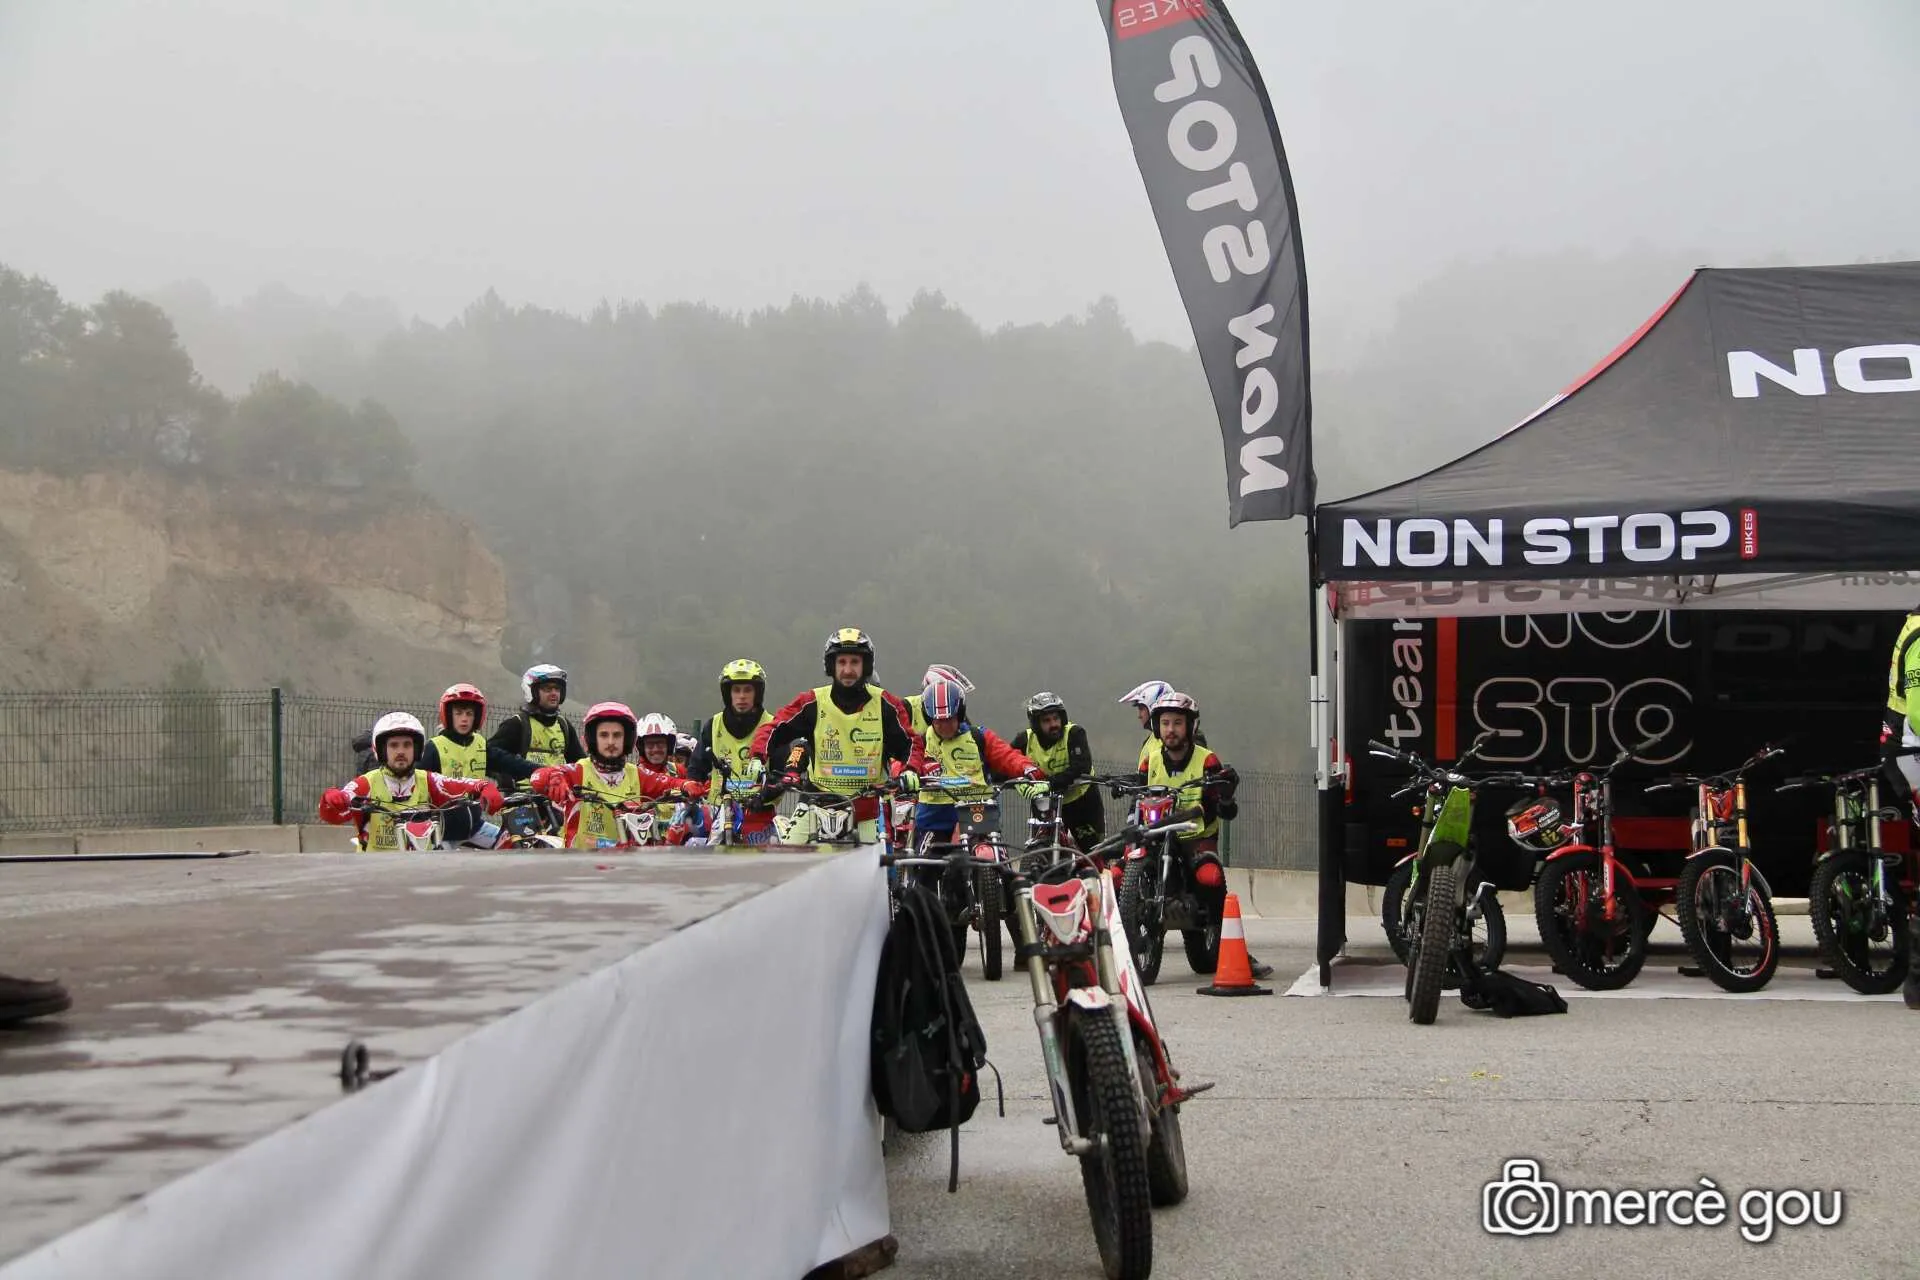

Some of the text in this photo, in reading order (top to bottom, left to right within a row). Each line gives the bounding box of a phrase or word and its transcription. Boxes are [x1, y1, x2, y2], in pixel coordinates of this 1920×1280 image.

[1342, 510, 1731, 567] NON STOP
[1744, 512, 1754, 555] BIKES
